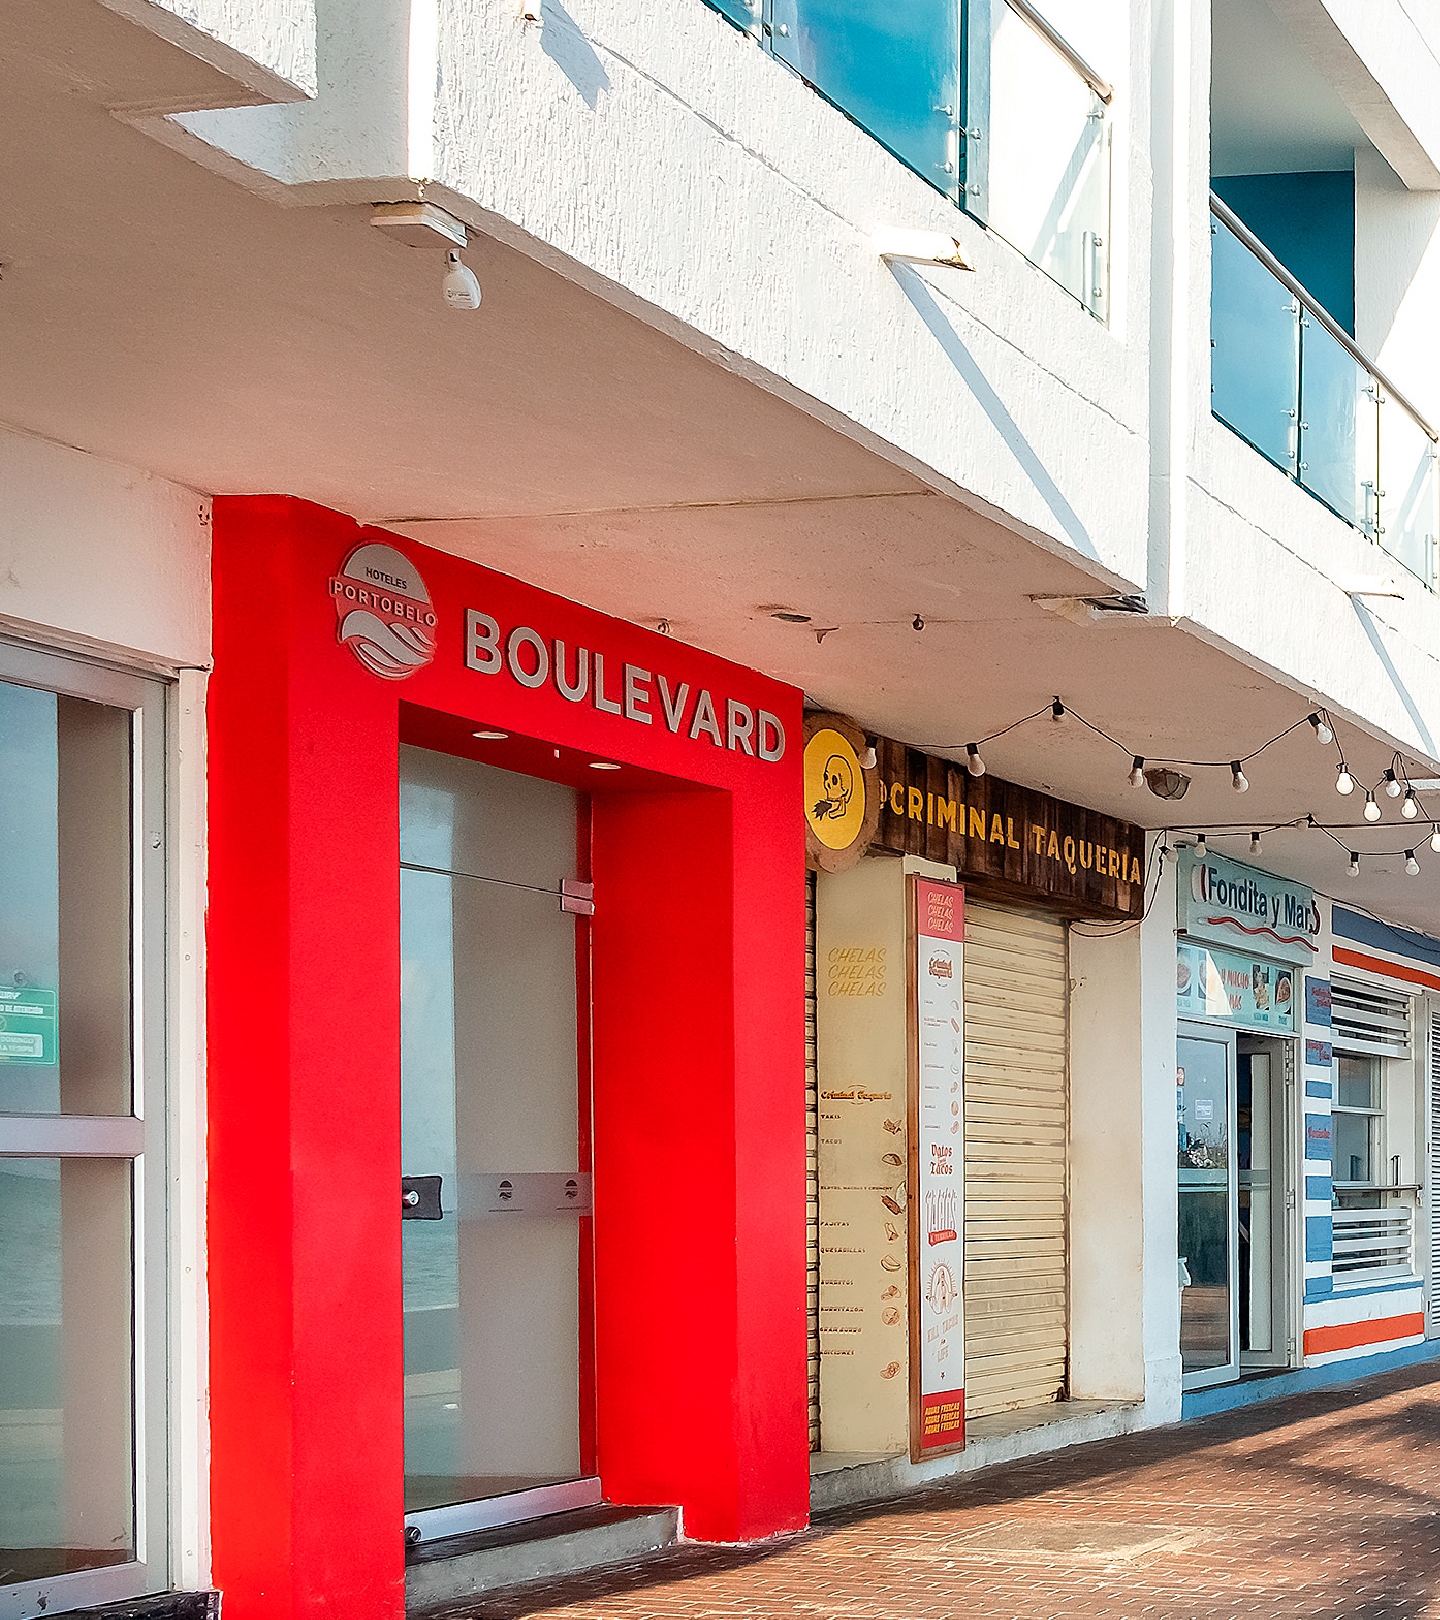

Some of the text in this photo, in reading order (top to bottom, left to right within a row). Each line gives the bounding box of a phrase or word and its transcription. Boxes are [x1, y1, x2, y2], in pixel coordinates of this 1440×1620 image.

[366, 567, 408, 590] HOTELES
[334, 581, 436, 627] PORTOBELO
[465, 608, 786, 762] BOULEVARD
[1031, 823, 1142, 886] TAQUERIA
[927, 891, 954, 908] CHELAS
[927, 904, 954, 920] CHELAS
[1271, 895, 1280, 929] y
[927, 917, 954, 934] CHELAS
[827, 947, 887, 963] CHELAS
[827, 964, 887, 980] CHELAS
[827, 981, 887, 996] CHELAS
